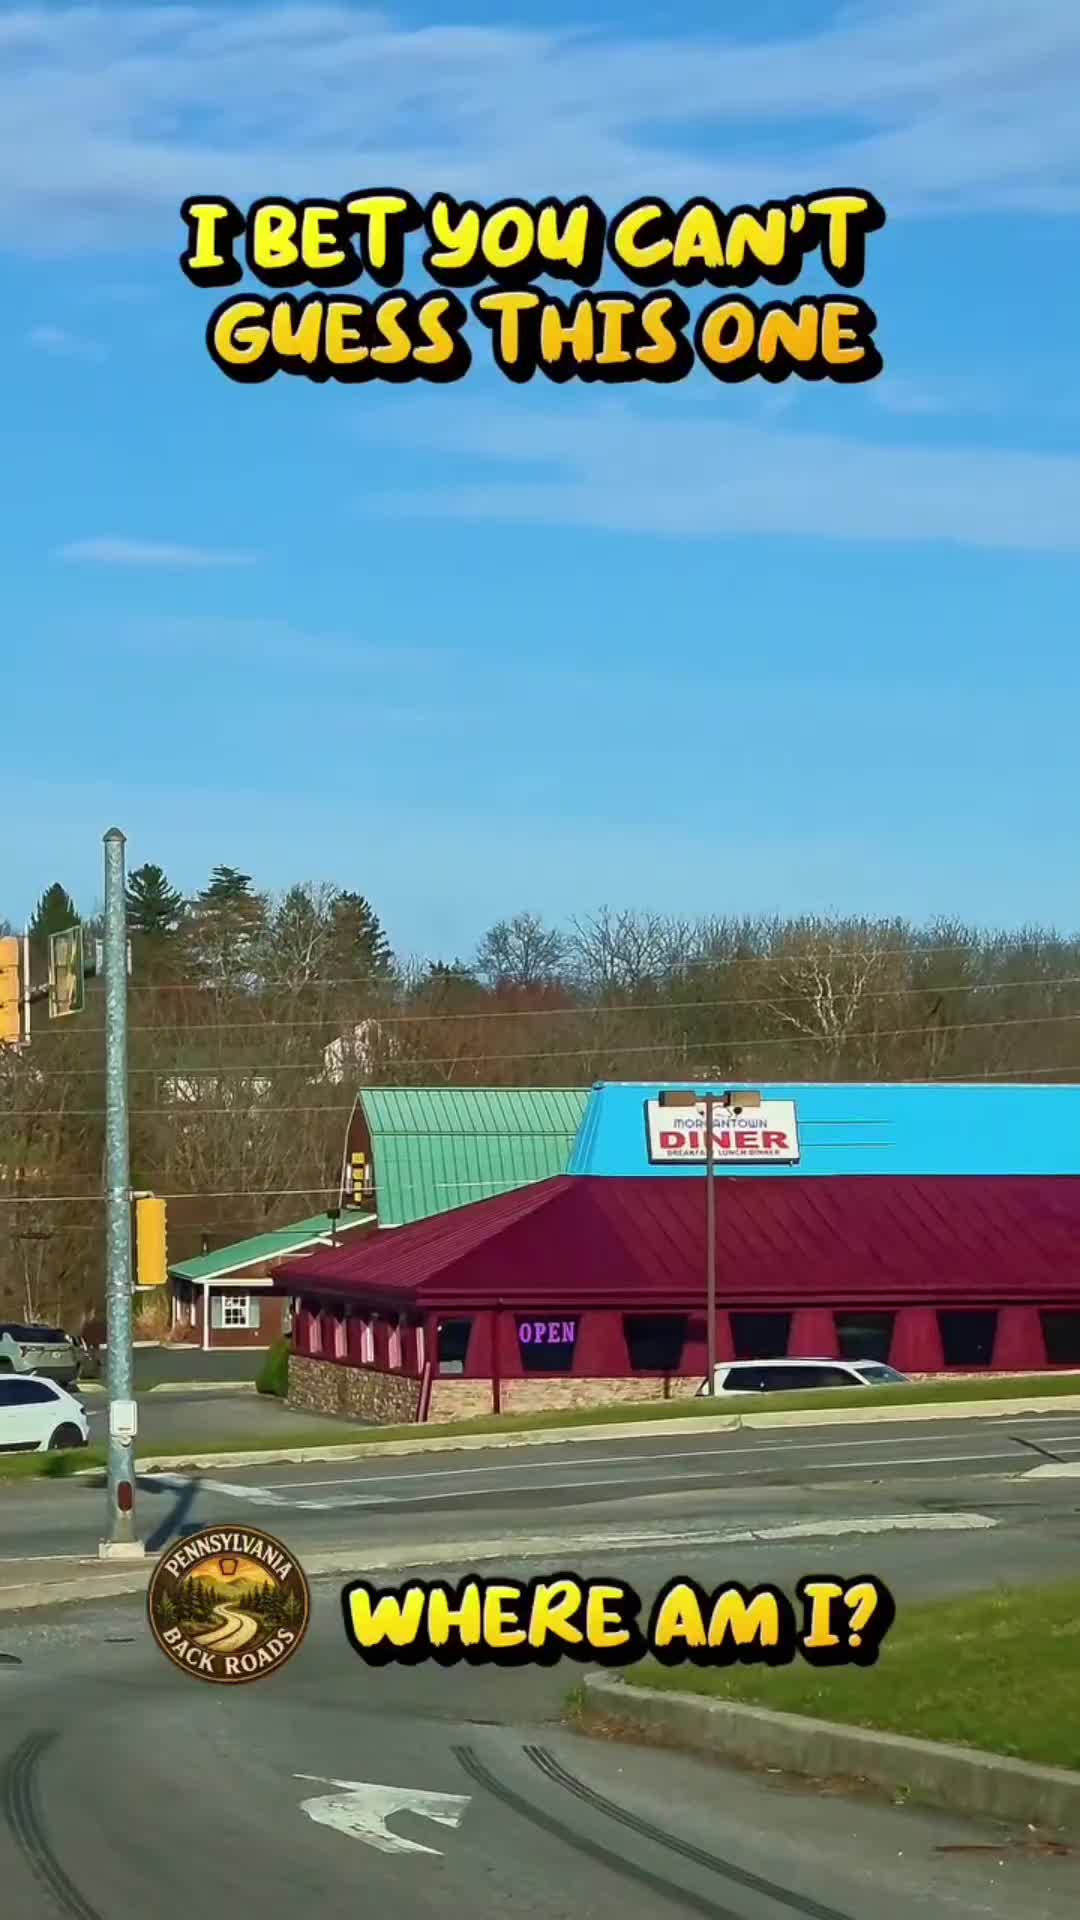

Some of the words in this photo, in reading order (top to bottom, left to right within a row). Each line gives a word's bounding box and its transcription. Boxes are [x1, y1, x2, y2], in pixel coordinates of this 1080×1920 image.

[673, 1118, 768, 1129] MORANTOWN
[659, 1131, 789, 1149] DINER
[518, 1321, 576, 1344] OPEN
